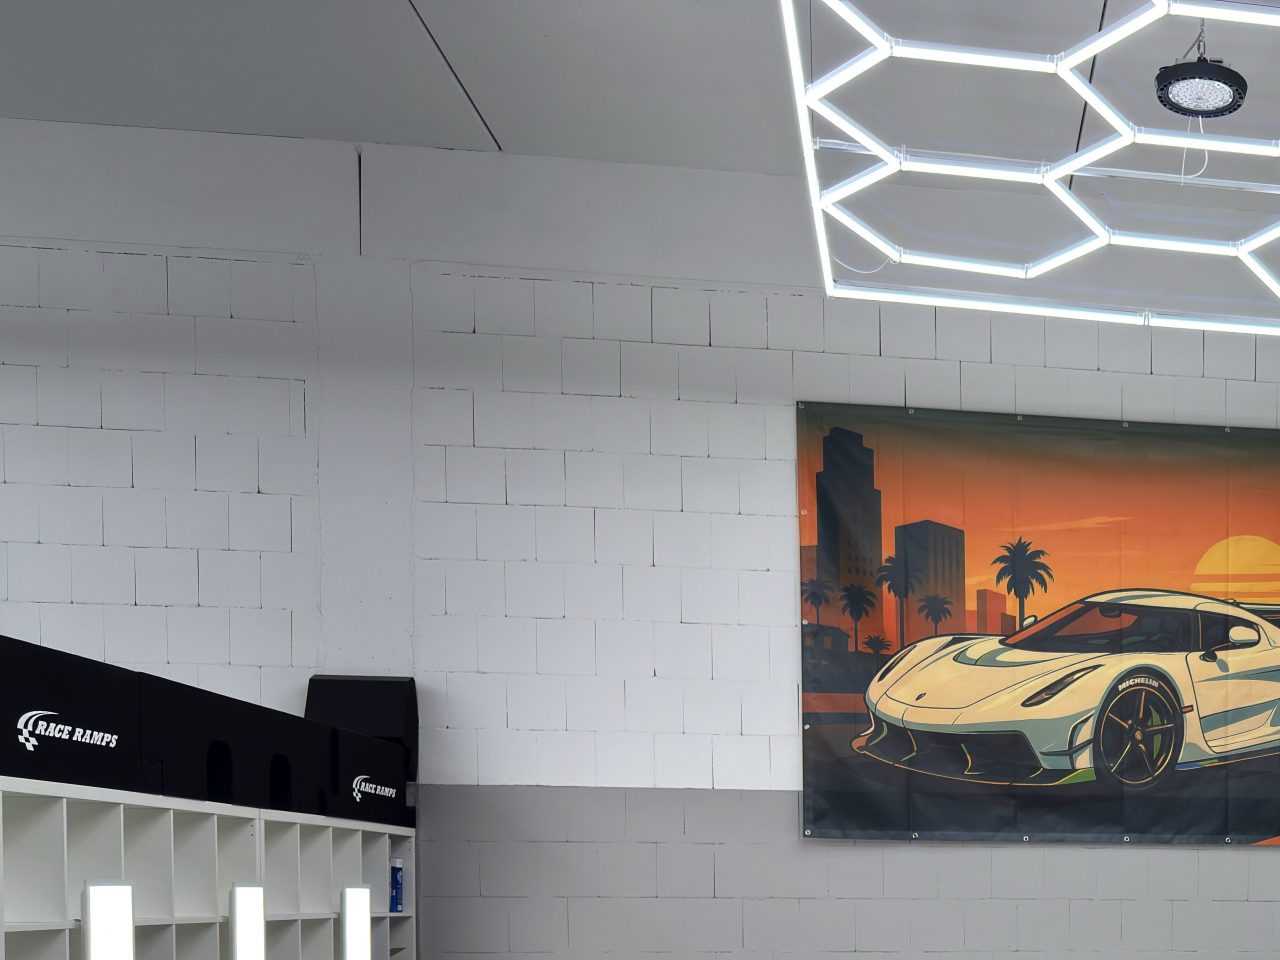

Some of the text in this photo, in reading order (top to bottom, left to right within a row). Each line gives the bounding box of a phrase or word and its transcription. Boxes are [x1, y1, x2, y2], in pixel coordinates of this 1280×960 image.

[1118, 677, 1159, 691] MICHELIN
[35, 720, 118, 748] RACE RAMPS
[360, 781, 397, 798] RACE RAMPS
